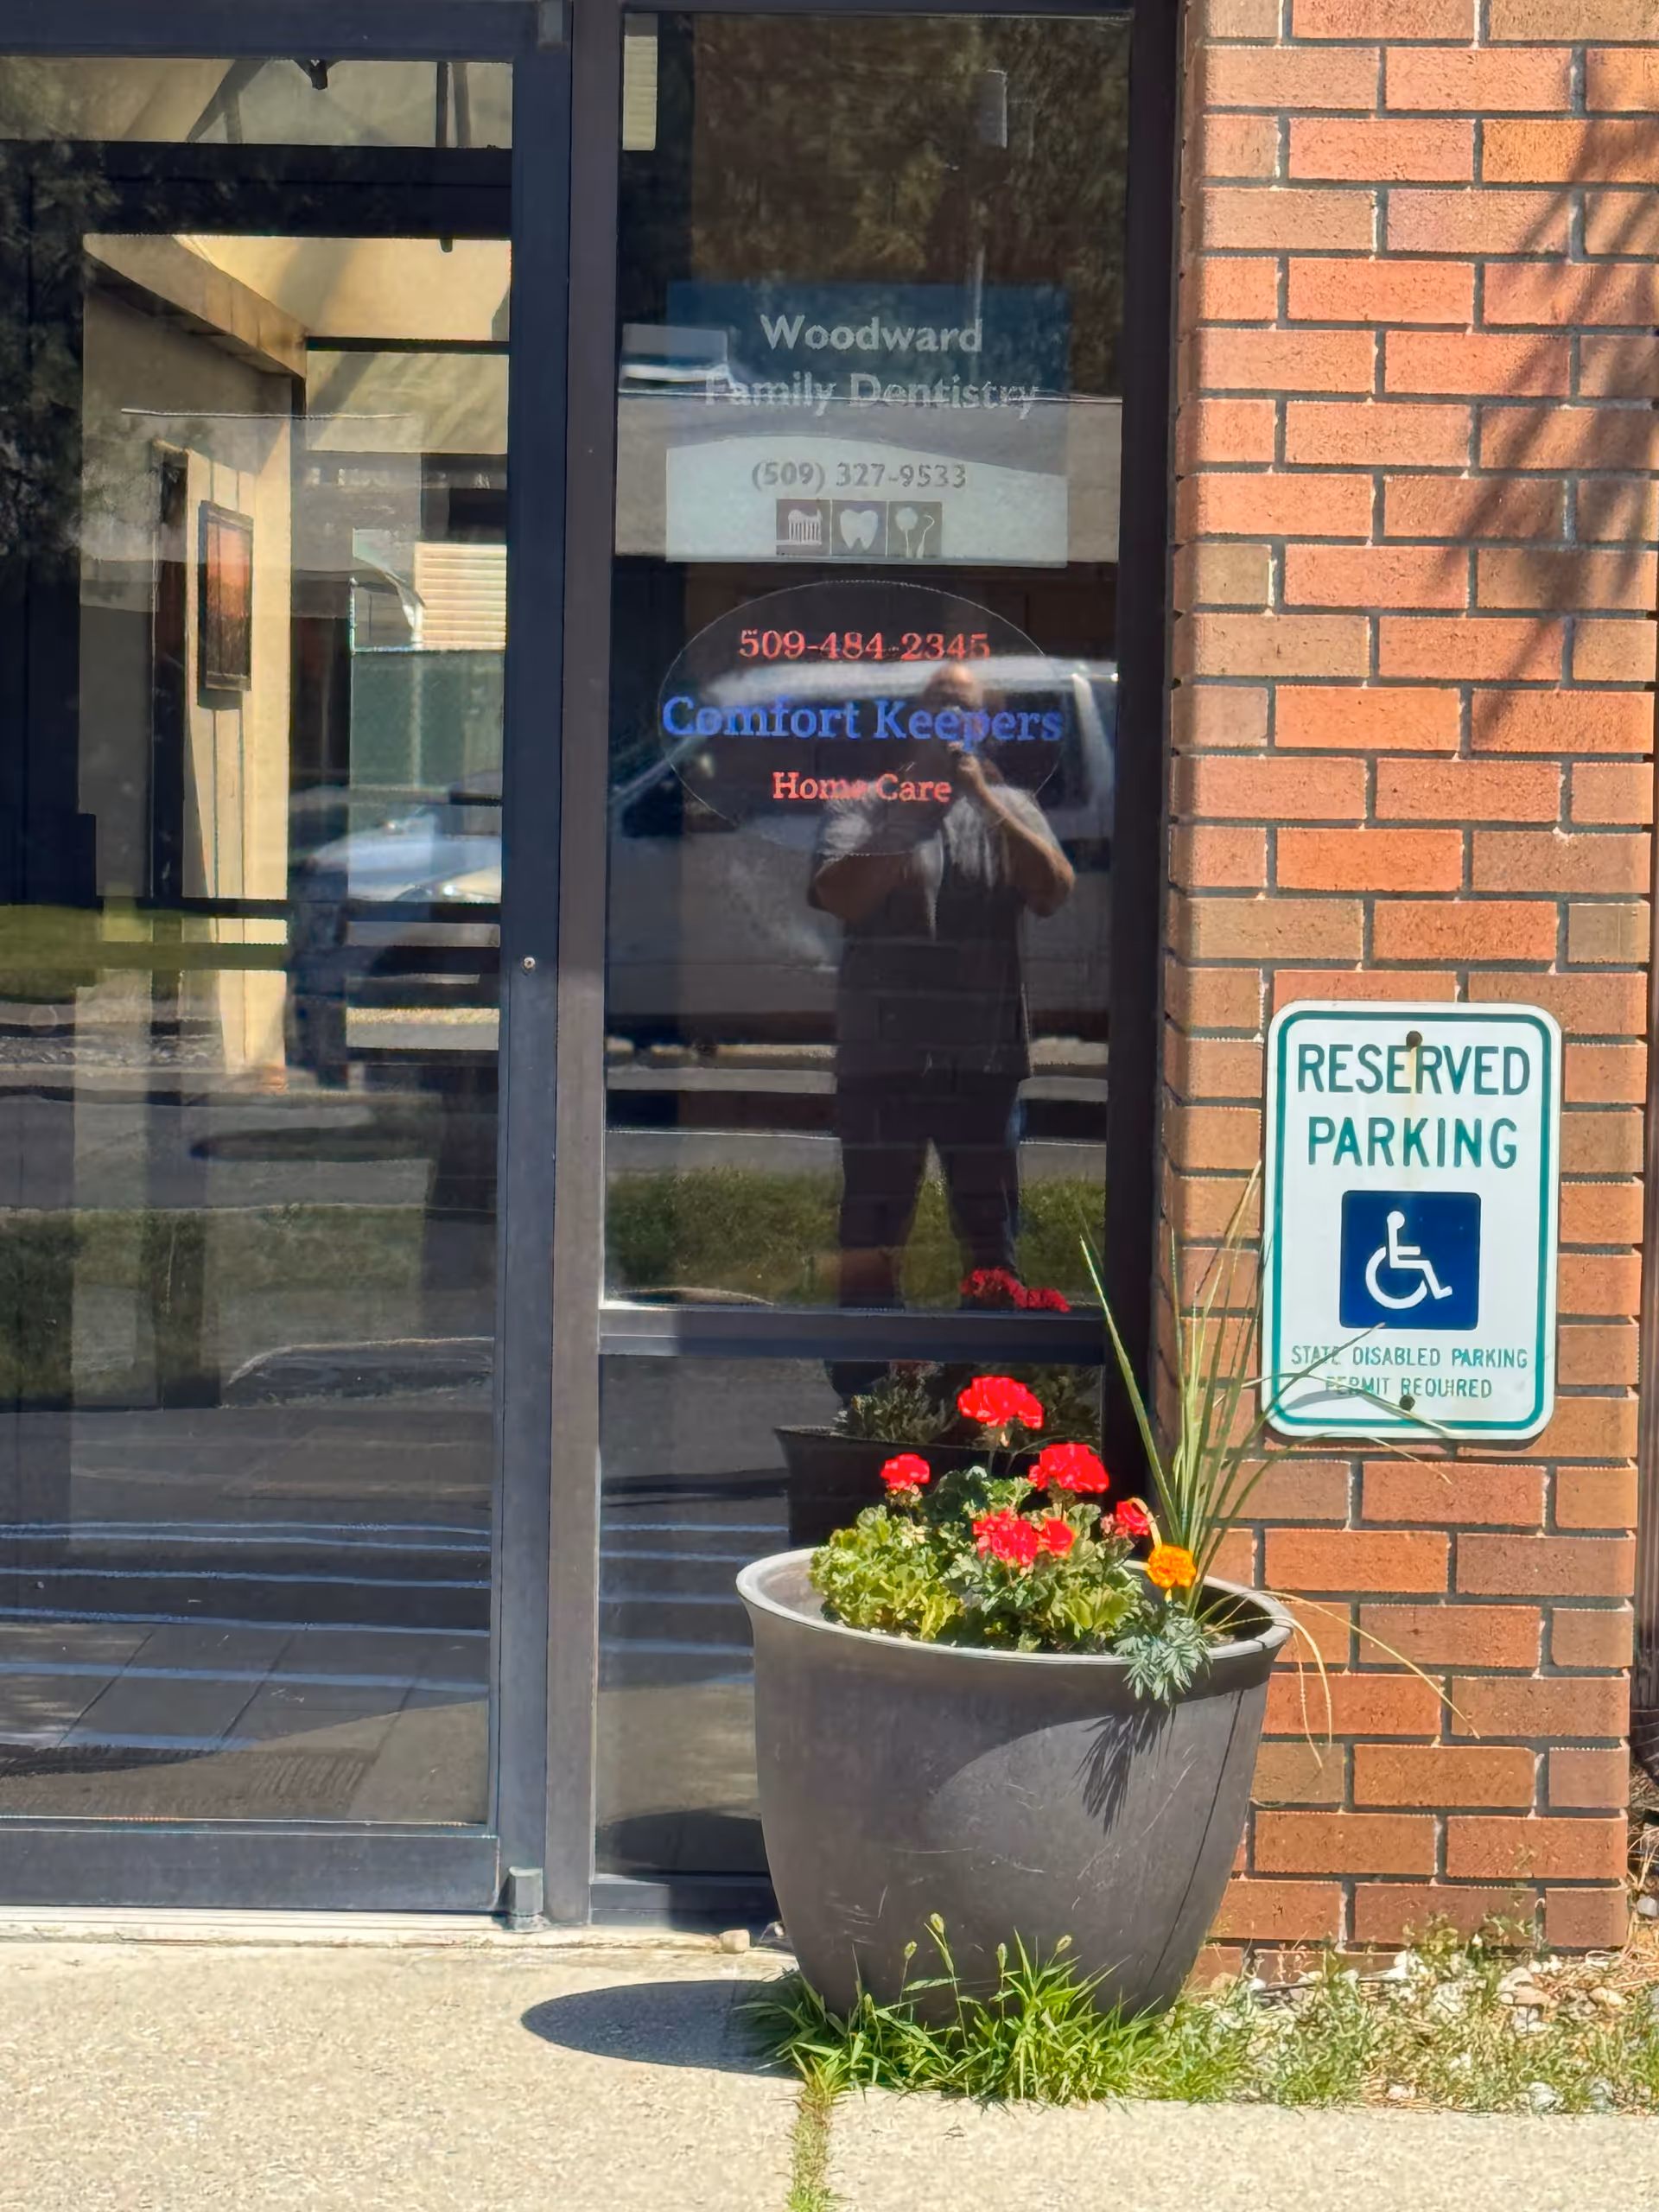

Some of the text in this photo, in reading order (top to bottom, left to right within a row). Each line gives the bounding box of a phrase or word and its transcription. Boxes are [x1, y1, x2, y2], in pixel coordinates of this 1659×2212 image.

[760, 313, 983, 353] Woodward
[704, 371, 1039, 420] Family Dentistry
[750, 461, 967, 492] (509) 327-9533
[738, 628, 991, 661] 509-484-2345
[662, 695, 1064, 753] Comfort Keepers
[772, 772, 952, 802] Home Care
[1298, 1043, 1530, 1096] RESERVED
[1308, 1116, 1517, 1170] PARKING
[1291, 1345, 1528, 1369] STATE DISABLED PARKING
